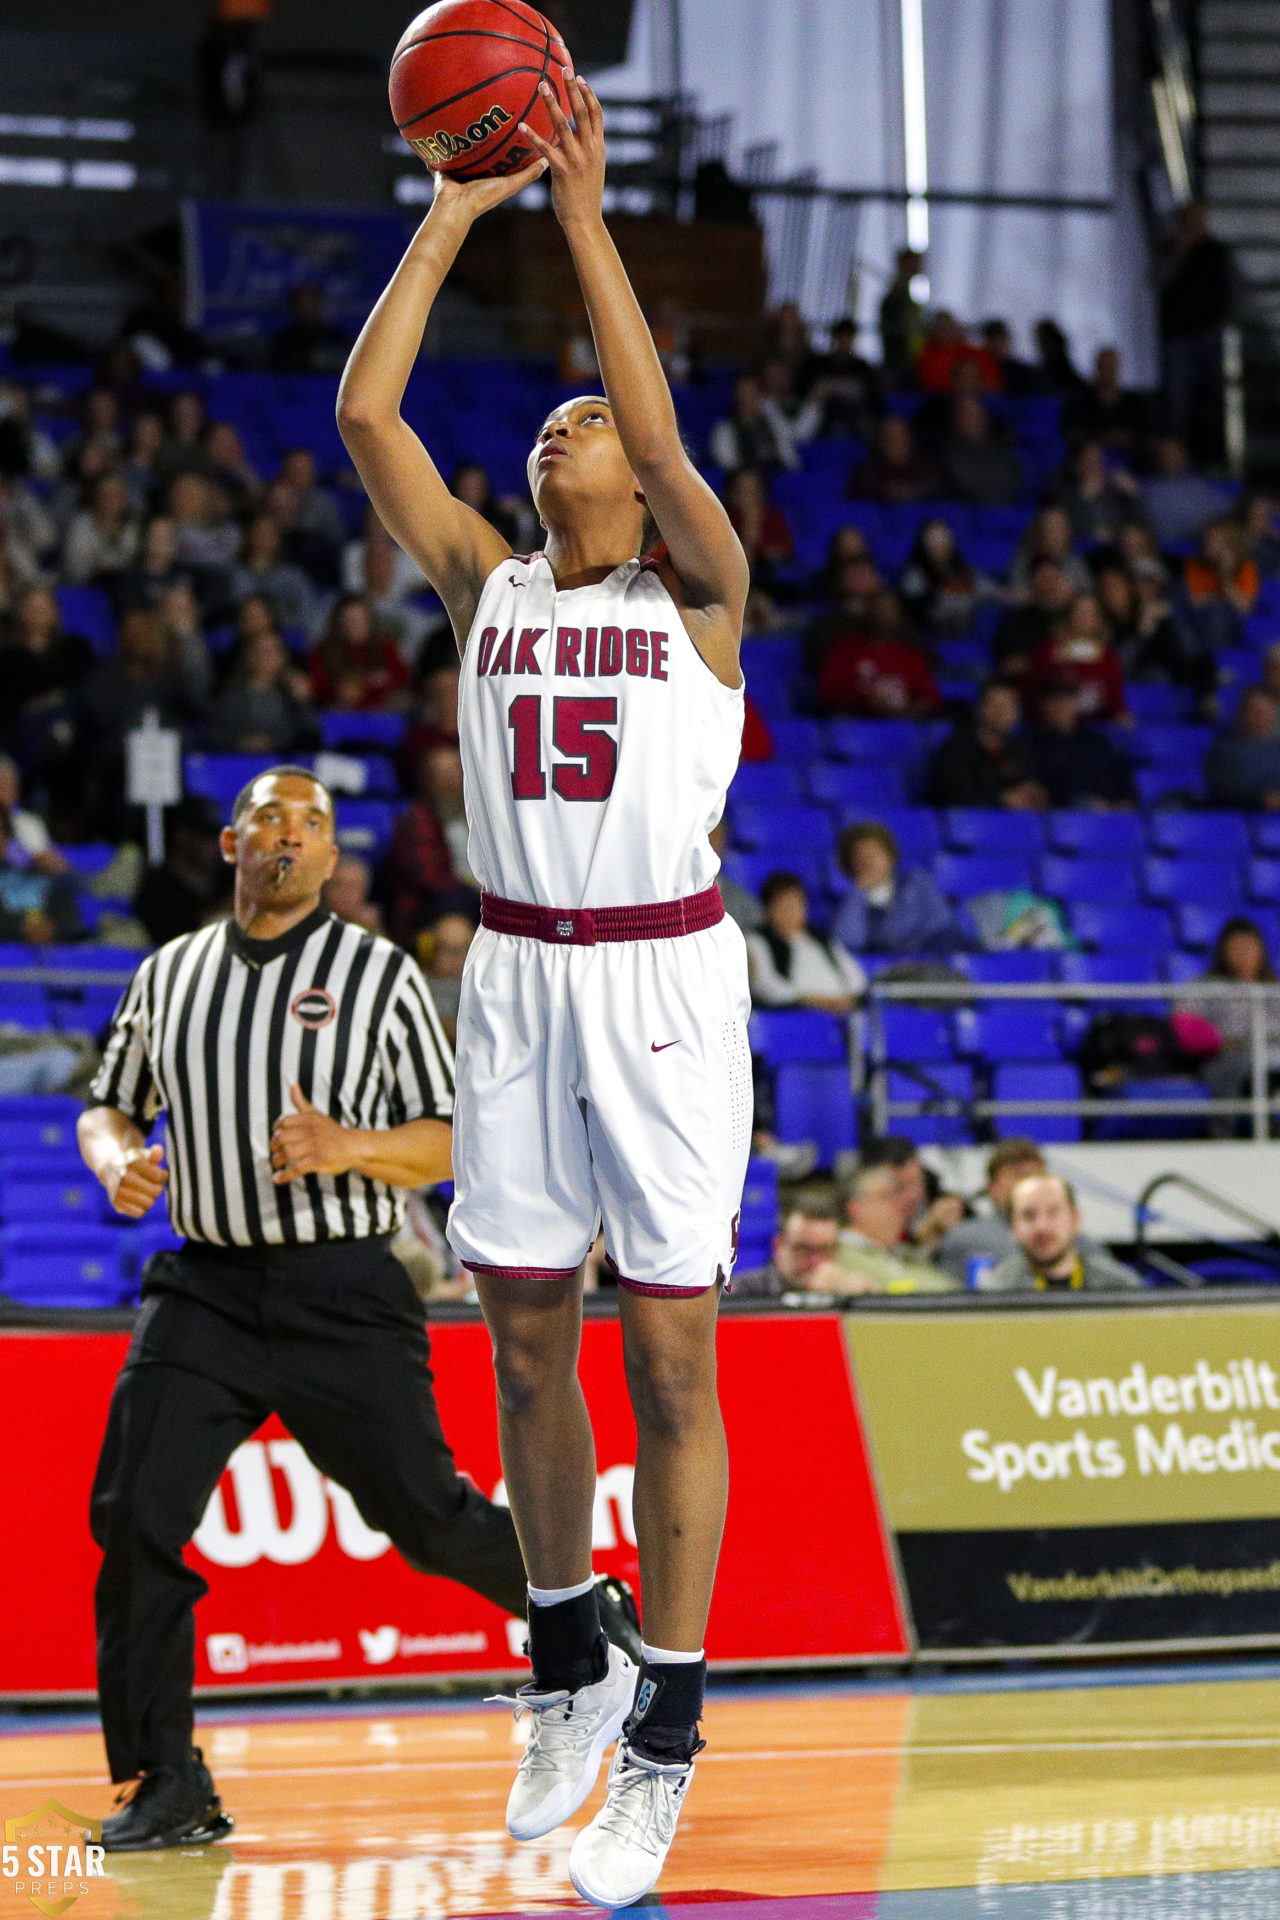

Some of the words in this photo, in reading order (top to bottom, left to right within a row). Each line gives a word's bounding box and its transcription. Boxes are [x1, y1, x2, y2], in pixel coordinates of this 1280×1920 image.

[409, 104, 514, 164] Wilson
[477, 626, 549, 678] OAK
[554, 626, 669, 682] RIDGE
[508, 694, 618, 803] 15
[1014, 1358, 1280, 1418] Vanderbilt
[961, 1429, 1126, 1493] Sports
